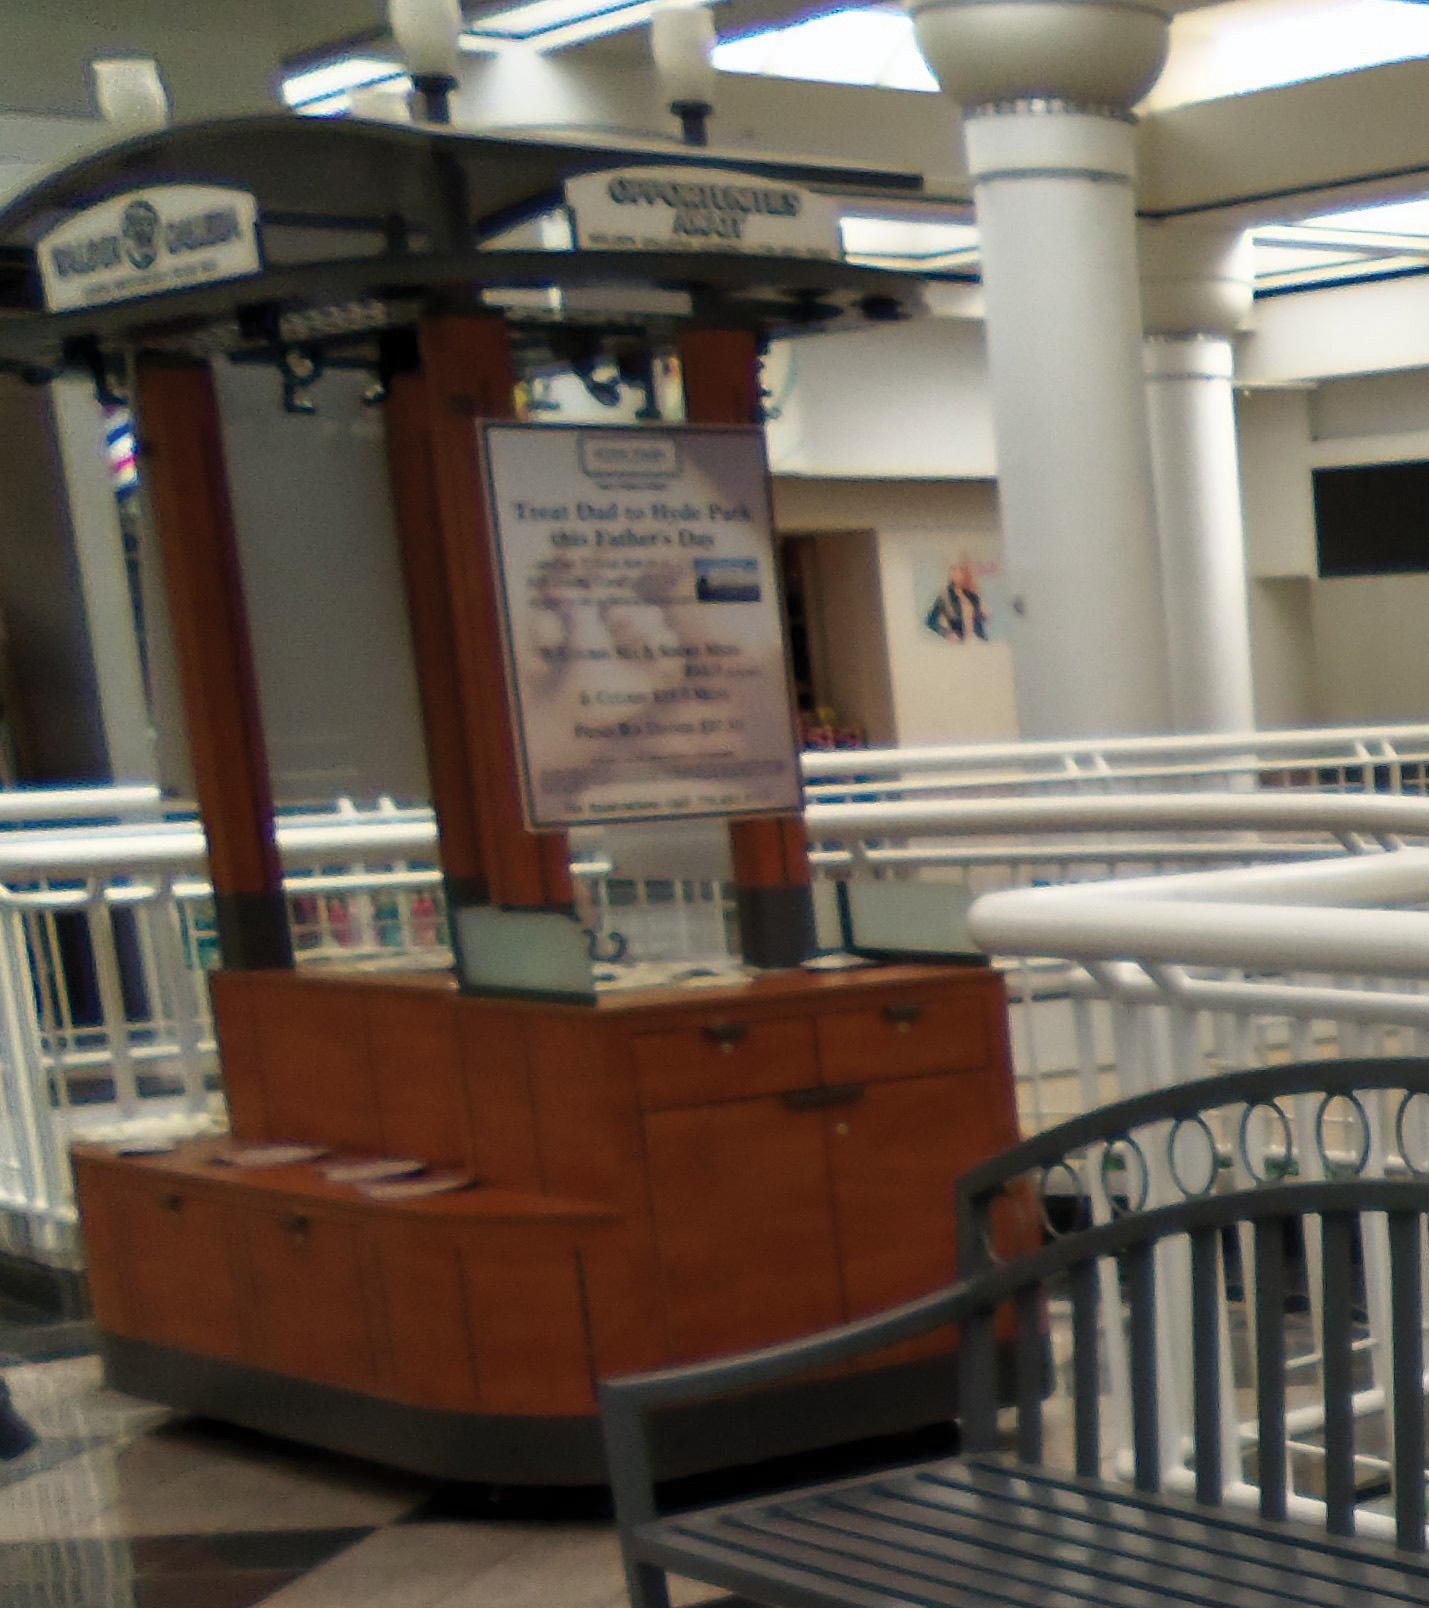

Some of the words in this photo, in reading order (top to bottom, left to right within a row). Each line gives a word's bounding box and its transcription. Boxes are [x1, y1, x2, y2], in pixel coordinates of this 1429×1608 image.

[513, 500, 569, 522] Treat
[576, 502, 619, 521] Dad
[624, 505, 646, 521] to
